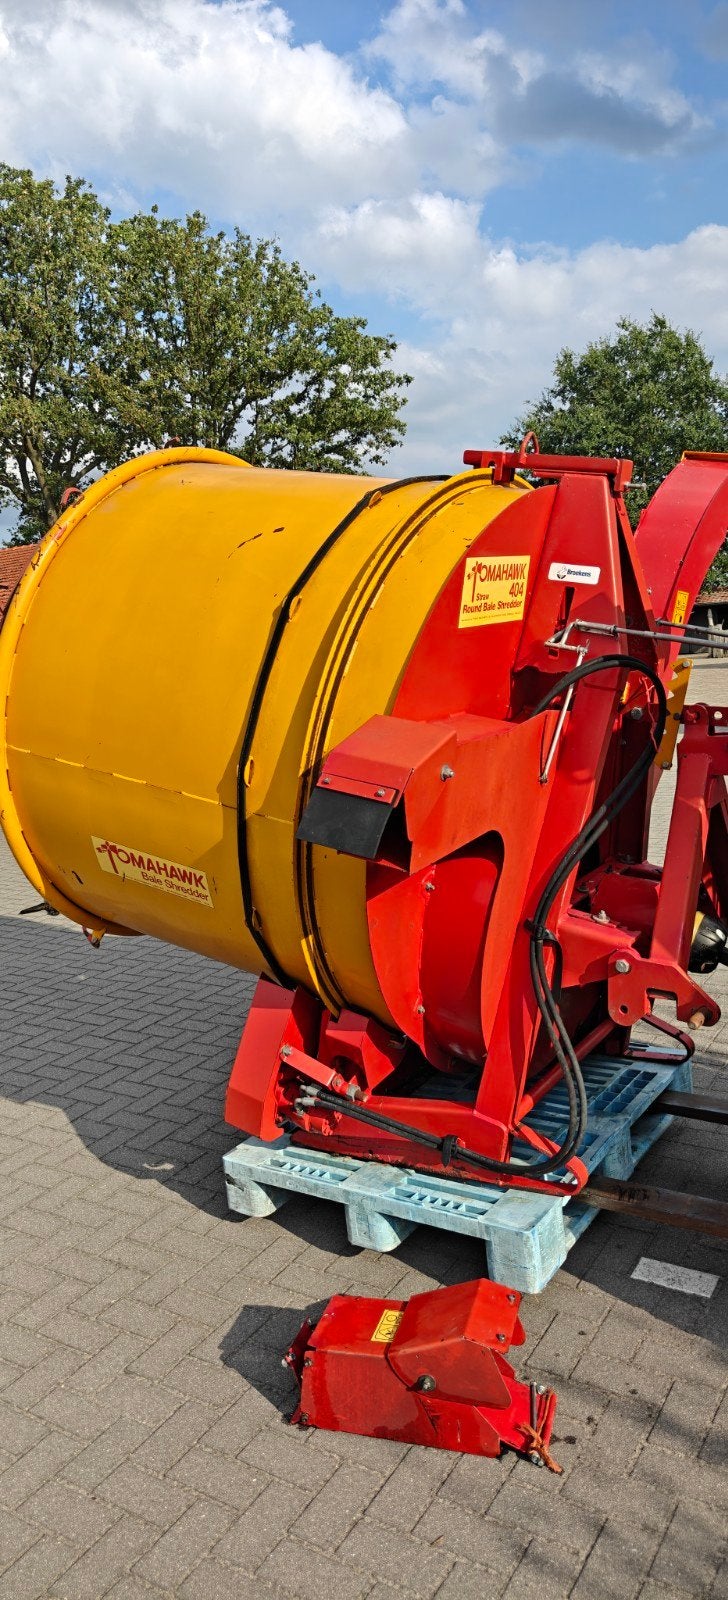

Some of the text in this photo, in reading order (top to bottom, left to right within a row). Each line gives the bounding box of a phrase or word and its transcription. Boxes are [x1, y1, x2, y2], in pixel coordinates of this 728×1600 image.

[467, 561, 527, 602] TOMAHAWK
[509, 582, 525, 597] 404
[463, 600, 522, 614] Round Bale Shredder
[476, 593, 490, 601] Straw
[96, 841, 206, 890] TOMAHAWK
[141, 872, 163, 886] Bale
[165, 880, 209, 901] Shredder
